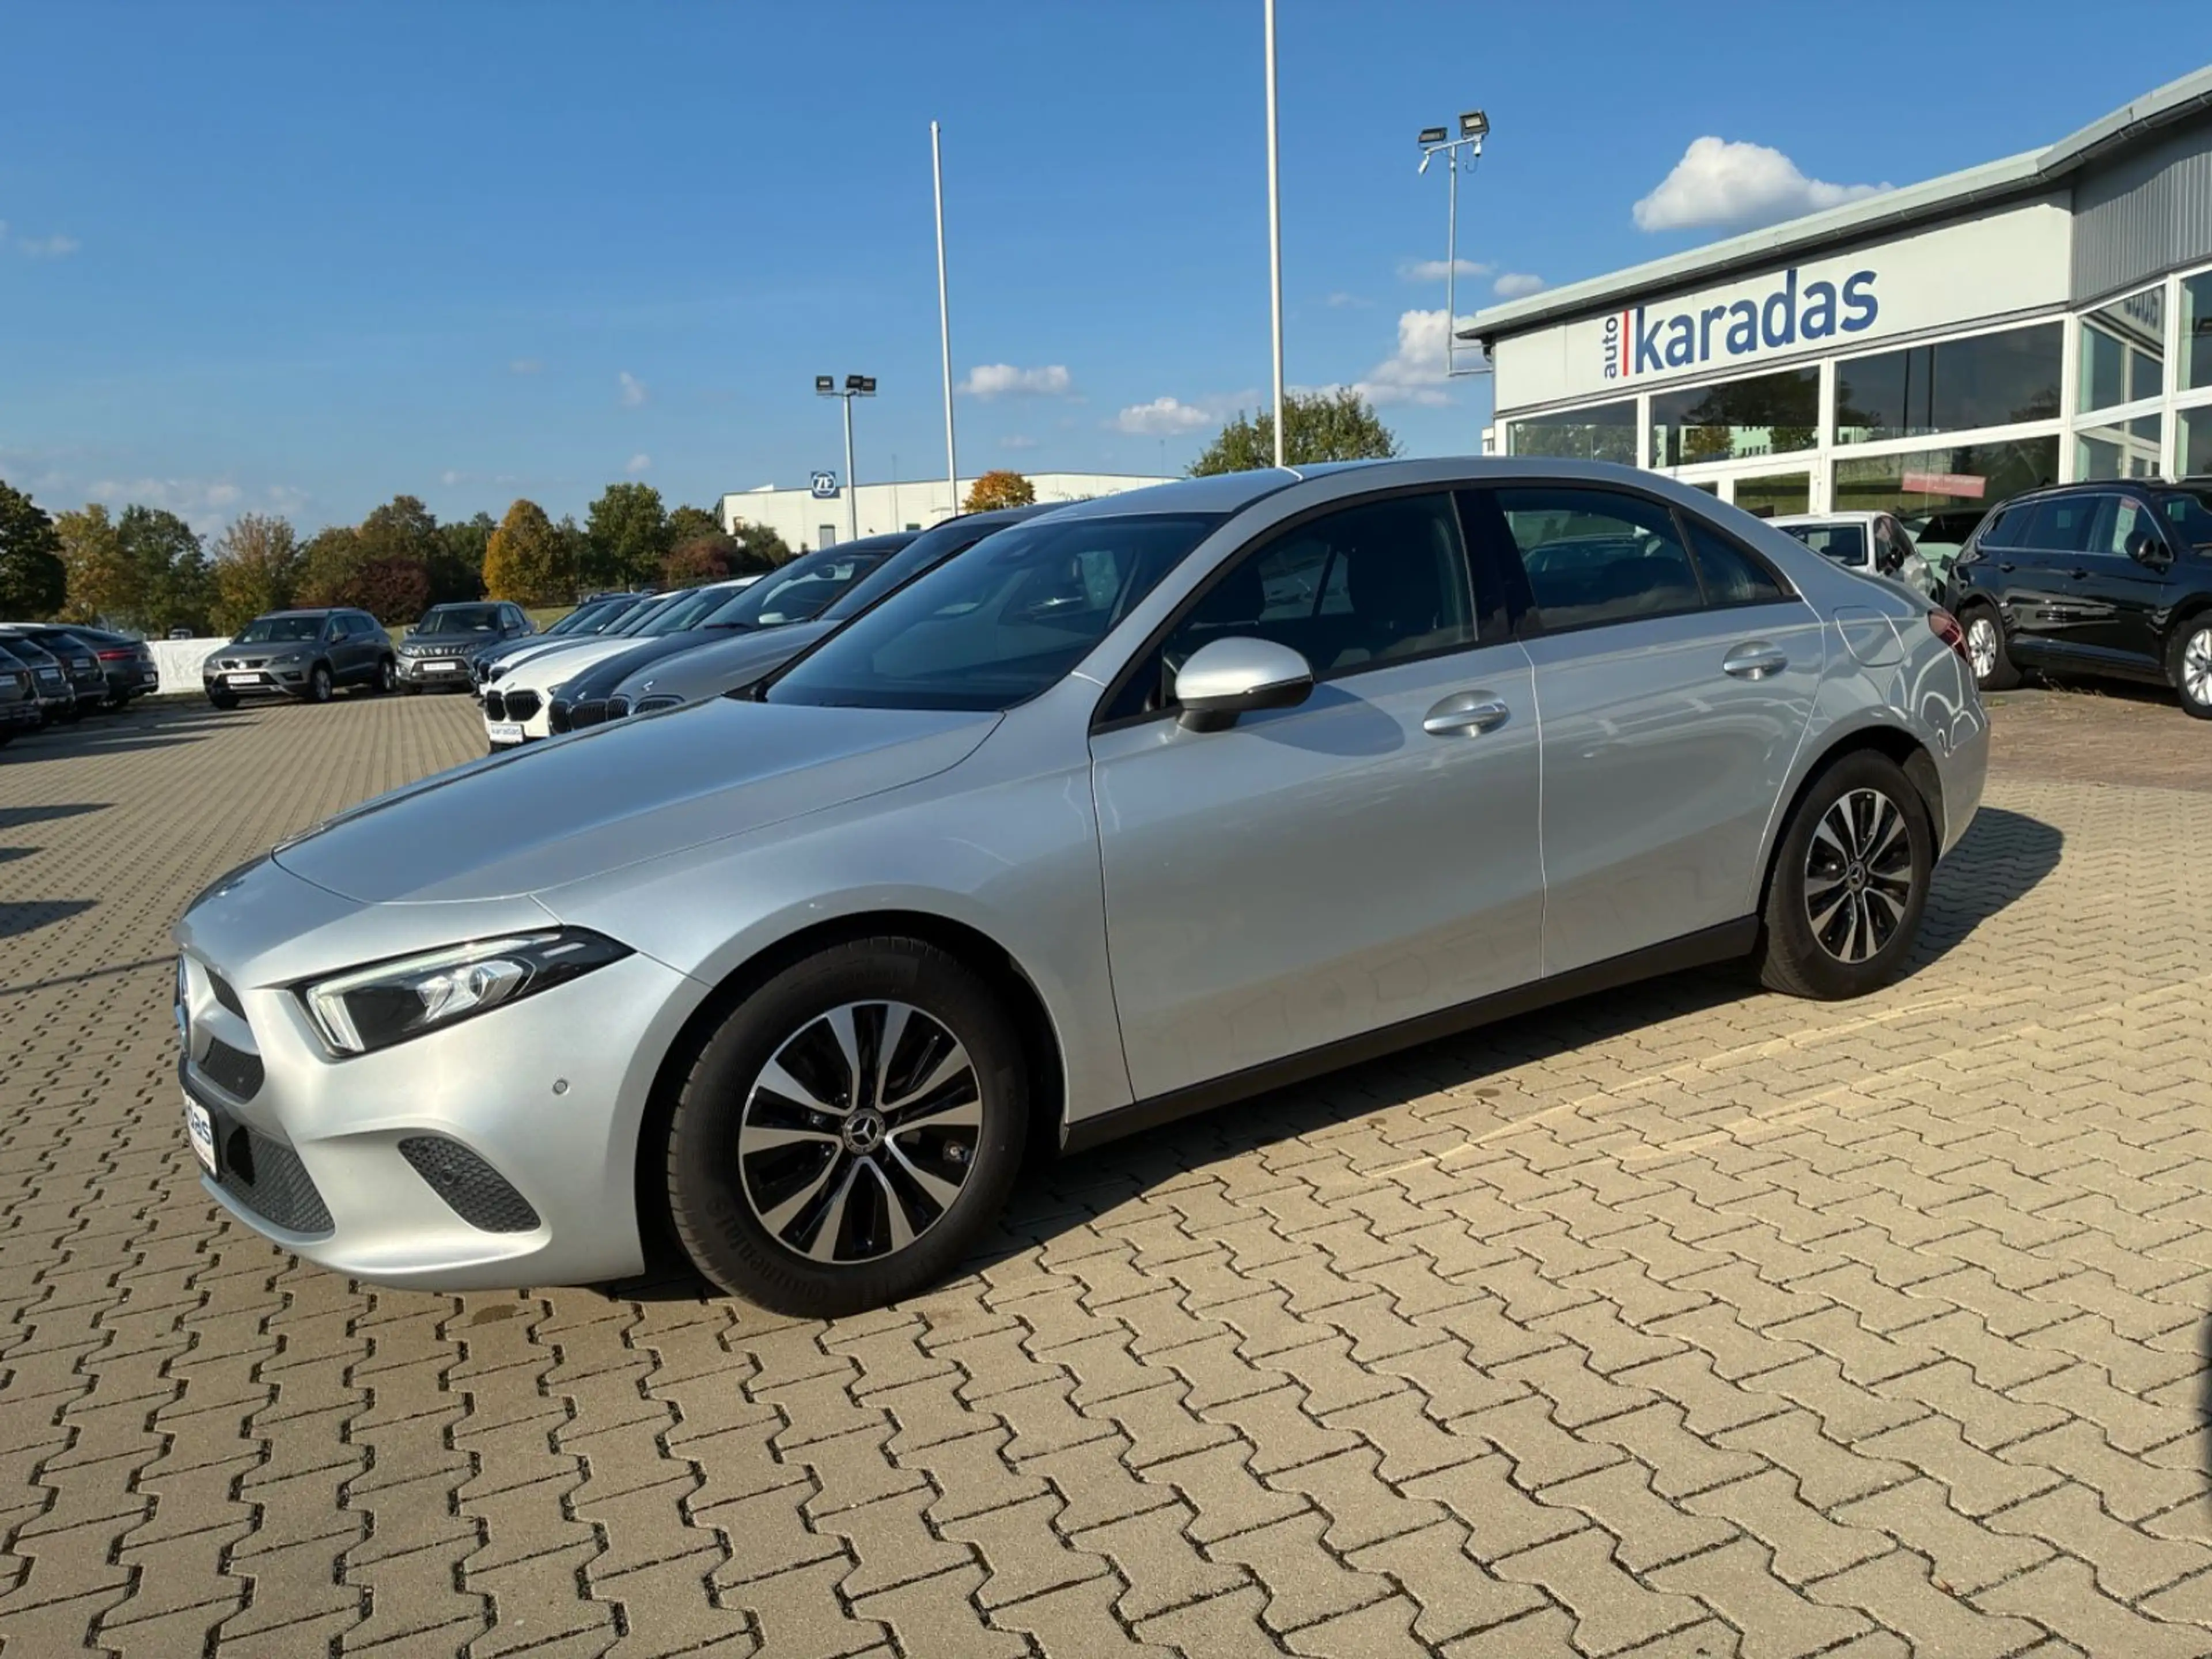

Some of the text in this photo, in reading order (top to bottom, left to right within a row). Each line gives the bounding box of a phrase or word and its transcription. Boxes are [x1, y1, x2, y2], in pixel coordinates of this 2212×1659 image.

[1601, 316, 1619, 380] auto
[1635, 268, 1878, 374] karadas
[813, 475, 835, 491] ZF
